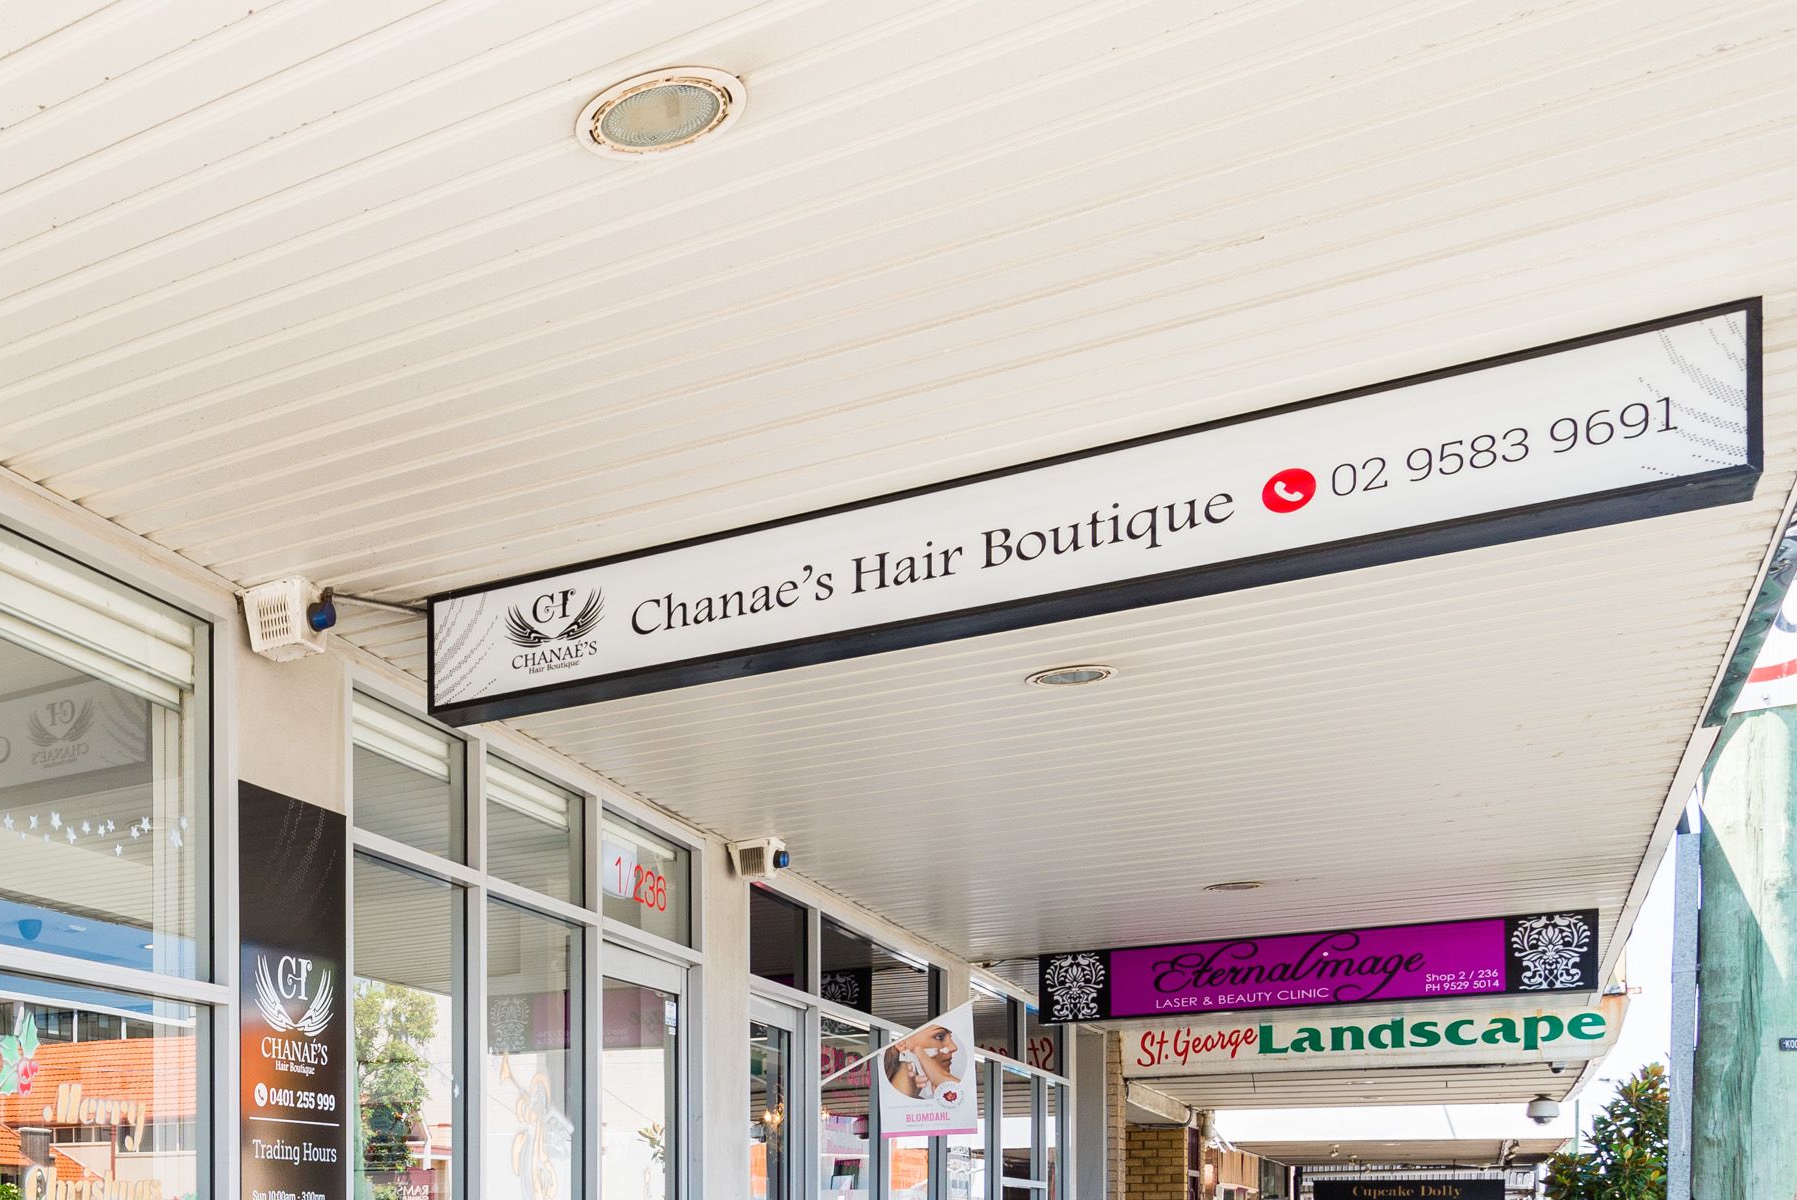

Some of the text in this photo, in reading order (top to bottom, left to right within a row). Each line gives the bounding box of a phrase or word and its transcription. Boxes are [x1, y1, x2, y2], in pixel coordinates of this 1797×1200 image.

[1330, 396, 1680, 499] 02 9583 9691
[630, 491, 1236, 637] Chanae's Hair Boutique
[528, 659, 580, 675] Hair Boutique
[615, 855, 667, 912] 1/236
[1425, 968, 1499, 983] Shop 2 236
[1425, 979, 1500, 992] PH 9529 5014
[1155, 987, 1330, 1009] LASER & BEAUTY CLINIC
[1258, 1012, 1607, 1055] Landscape
[275, 1060, 315, 1077] Hair Boutique
[269, 1087, 336, 1111] 0401 255 999
[42, 1083, 147, 1151] Merry
[905, 1111, 951, 1123] BLOMDAHL
[252, 1138, 338, 1166] Trading Hours
[1352, 1184, 1464, 1200] Cupcake Dolly
